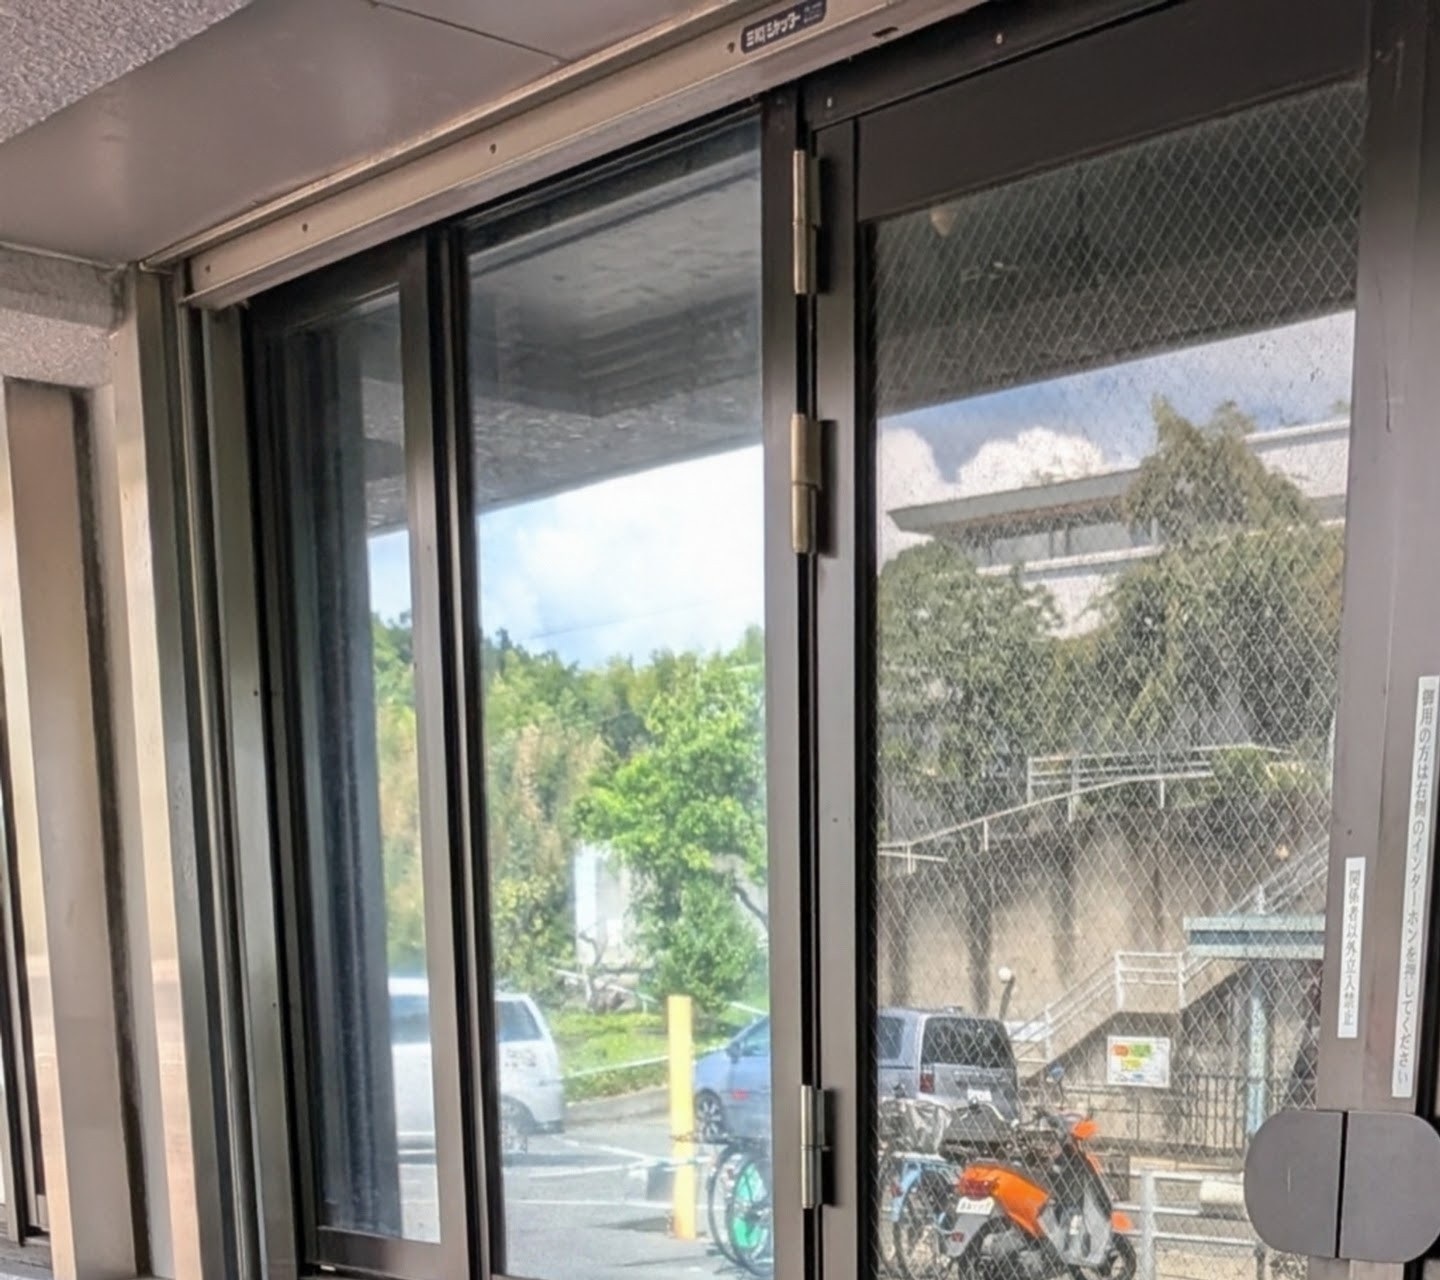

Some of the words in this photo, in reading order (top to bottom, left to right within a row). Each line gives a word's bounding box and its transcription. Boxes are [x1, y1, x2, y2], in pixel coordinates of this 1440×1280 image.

[1343, 869, 1362, 1027] 関係者以外立入禁止
